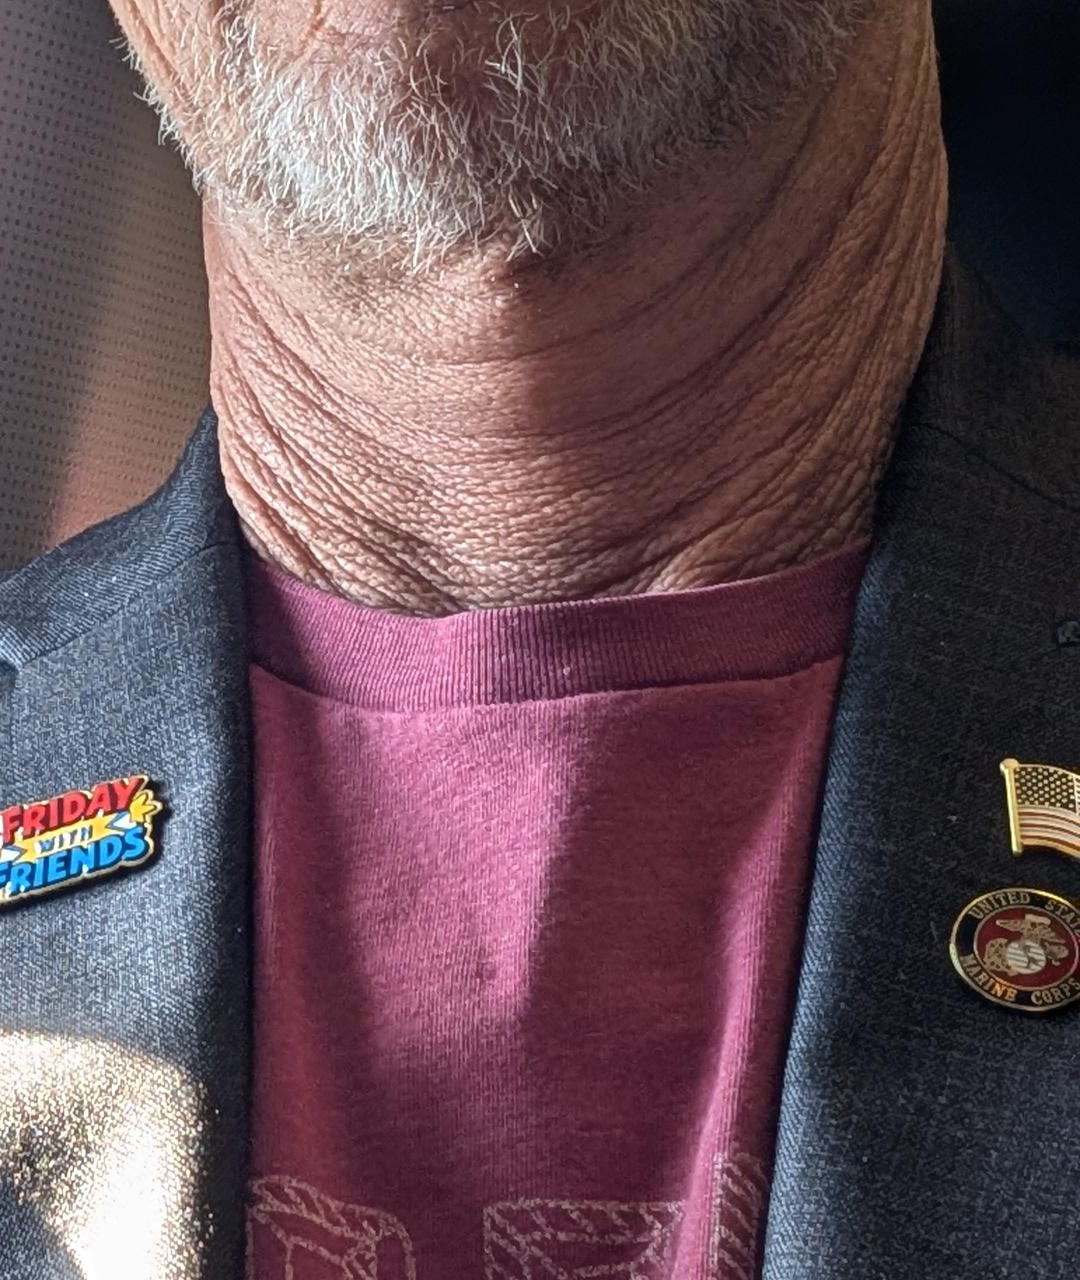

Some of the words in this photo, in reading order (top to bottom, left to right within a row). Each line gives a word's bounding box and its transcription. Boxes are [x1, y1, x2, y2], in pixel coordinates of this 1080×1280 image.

[1, 777, 143, 843] FRIDAY
[37, 824, 94, 852] WITH
[968, 890, 1031, 920] UNITED
